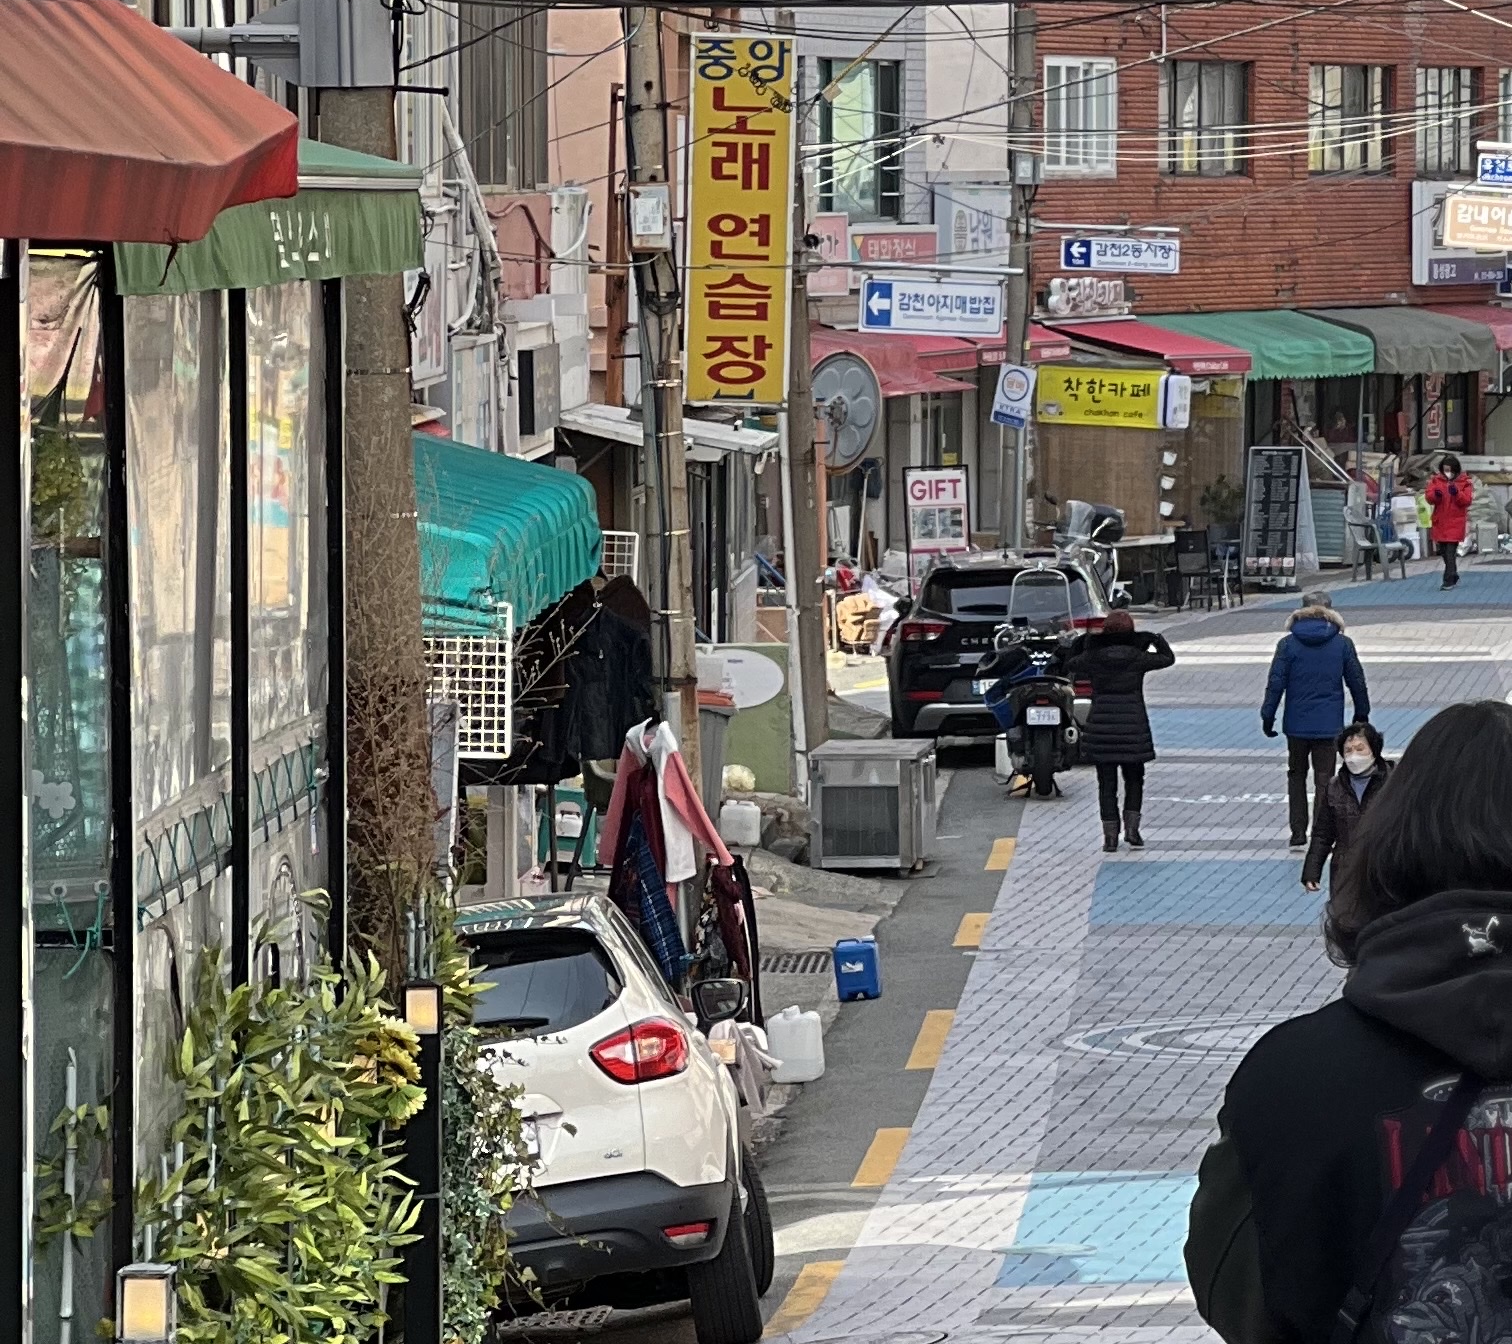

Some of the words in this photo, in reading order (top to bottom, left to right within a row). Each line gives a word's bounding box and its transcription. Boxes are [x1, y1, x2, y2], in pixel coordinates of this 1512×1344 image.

[695, 38, 792, 84] 중앙
[1095, 242, 1172, 260] 감천2동시장
[910, 478, 962, 501] GIFT
